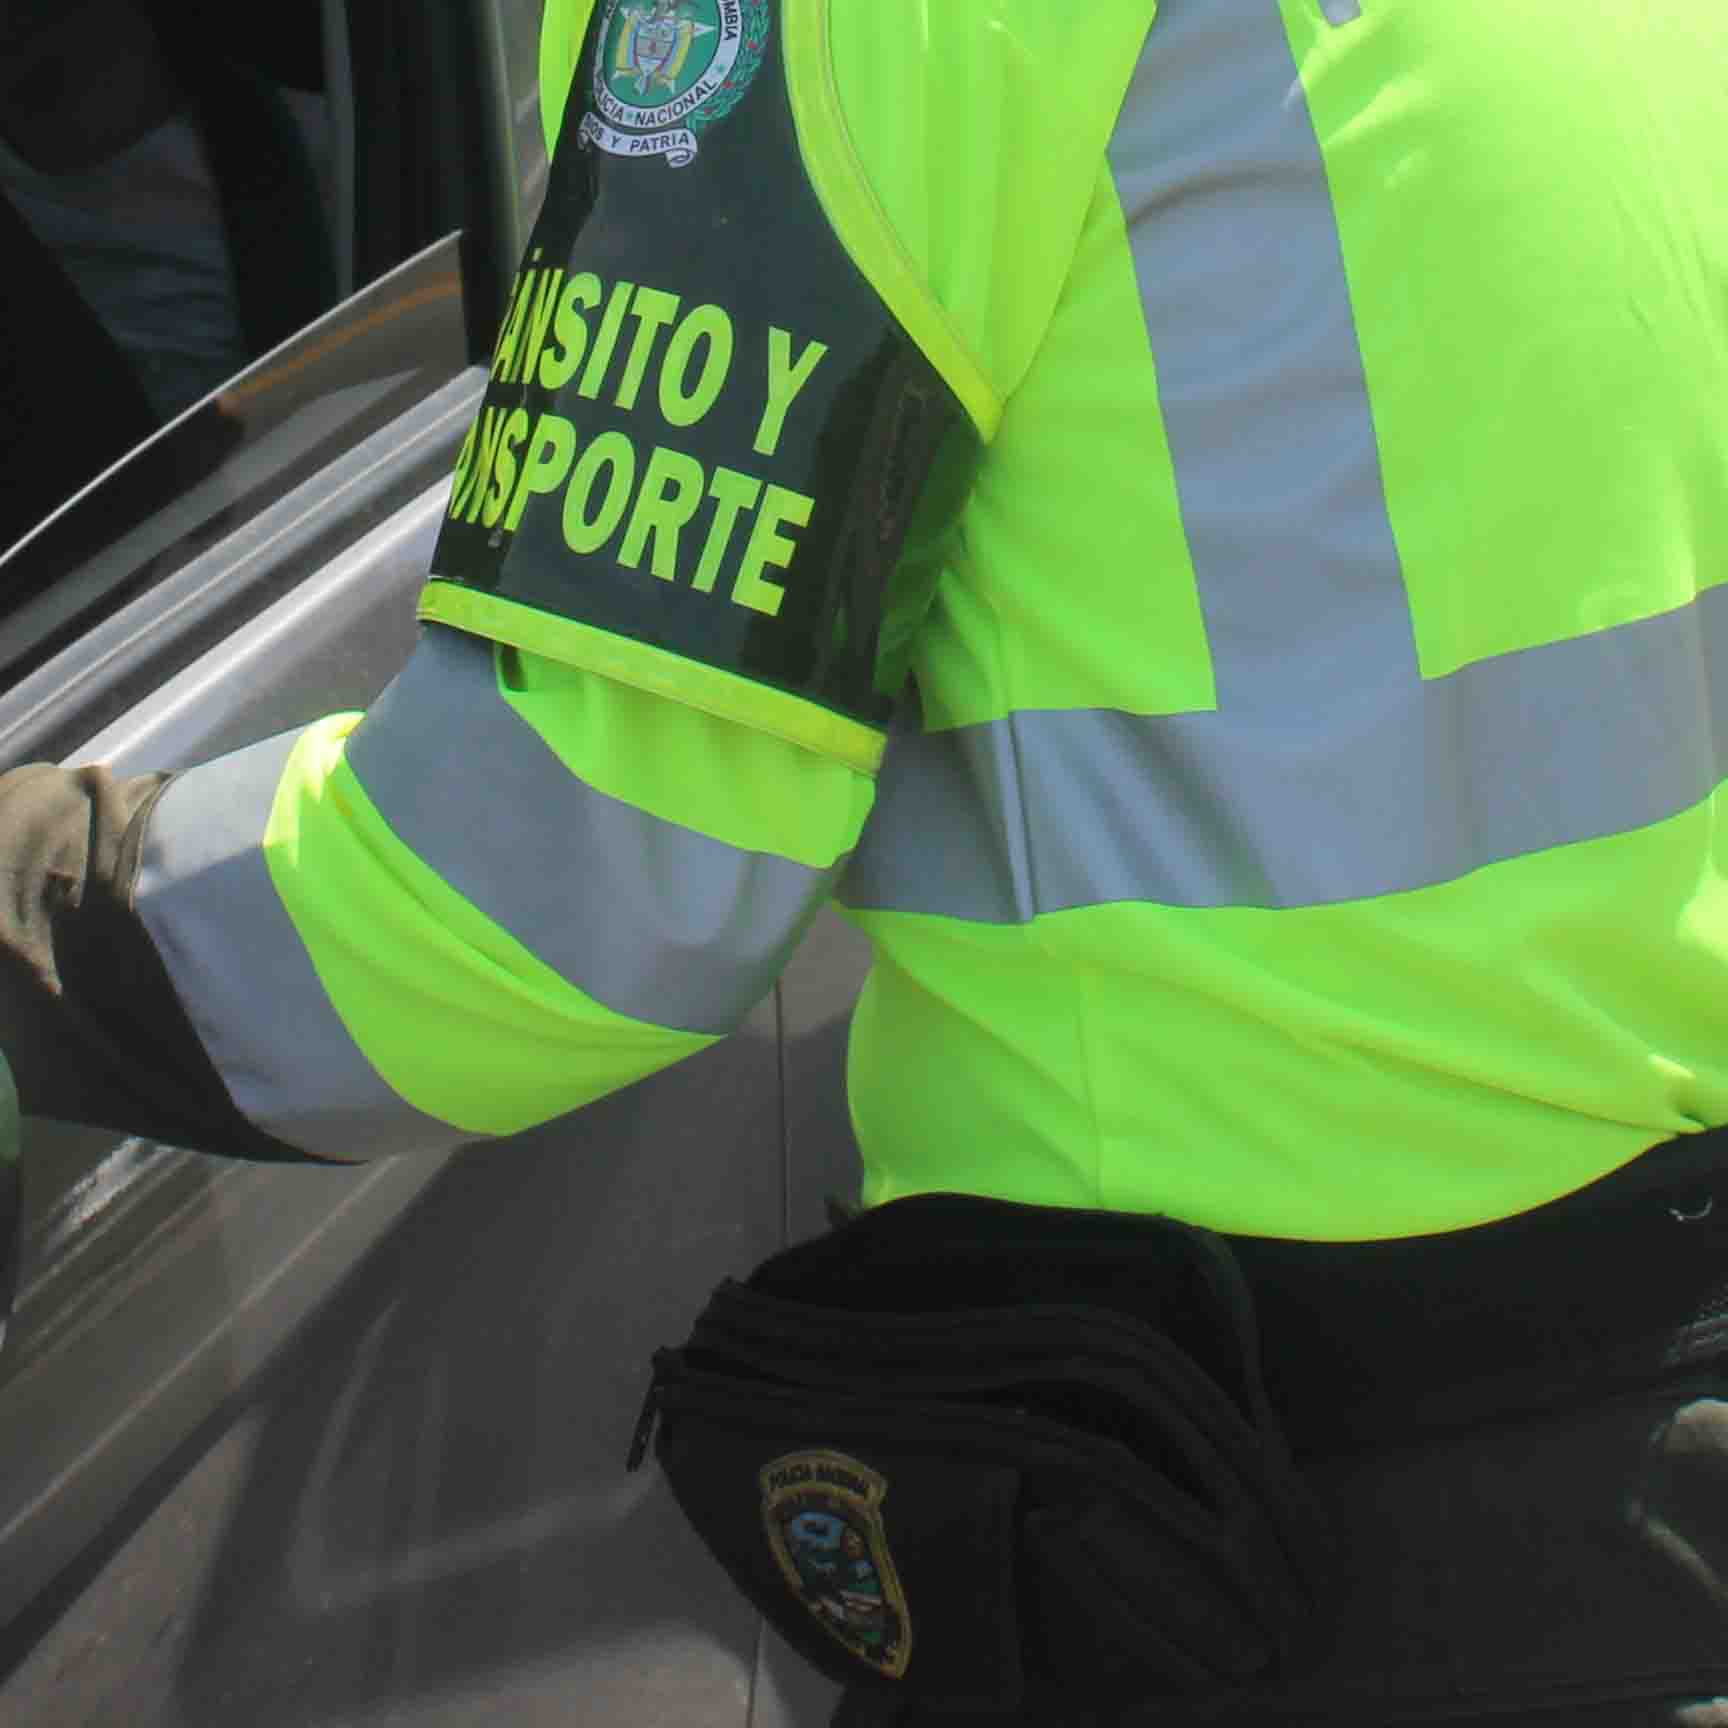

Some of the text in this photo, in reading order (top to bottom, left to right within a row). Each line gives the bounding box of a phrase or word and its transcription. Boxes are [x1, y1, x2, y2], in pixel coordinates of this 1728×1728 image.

[609, 134, 622, 149] Y
[629, 132, 690, 153] PATRIA
[633, 80, 718, 127] NACIONAL
[490, 247, 830, 456] ÁNSITO Y
[449, 404, 816, 618] ANSPORTE
